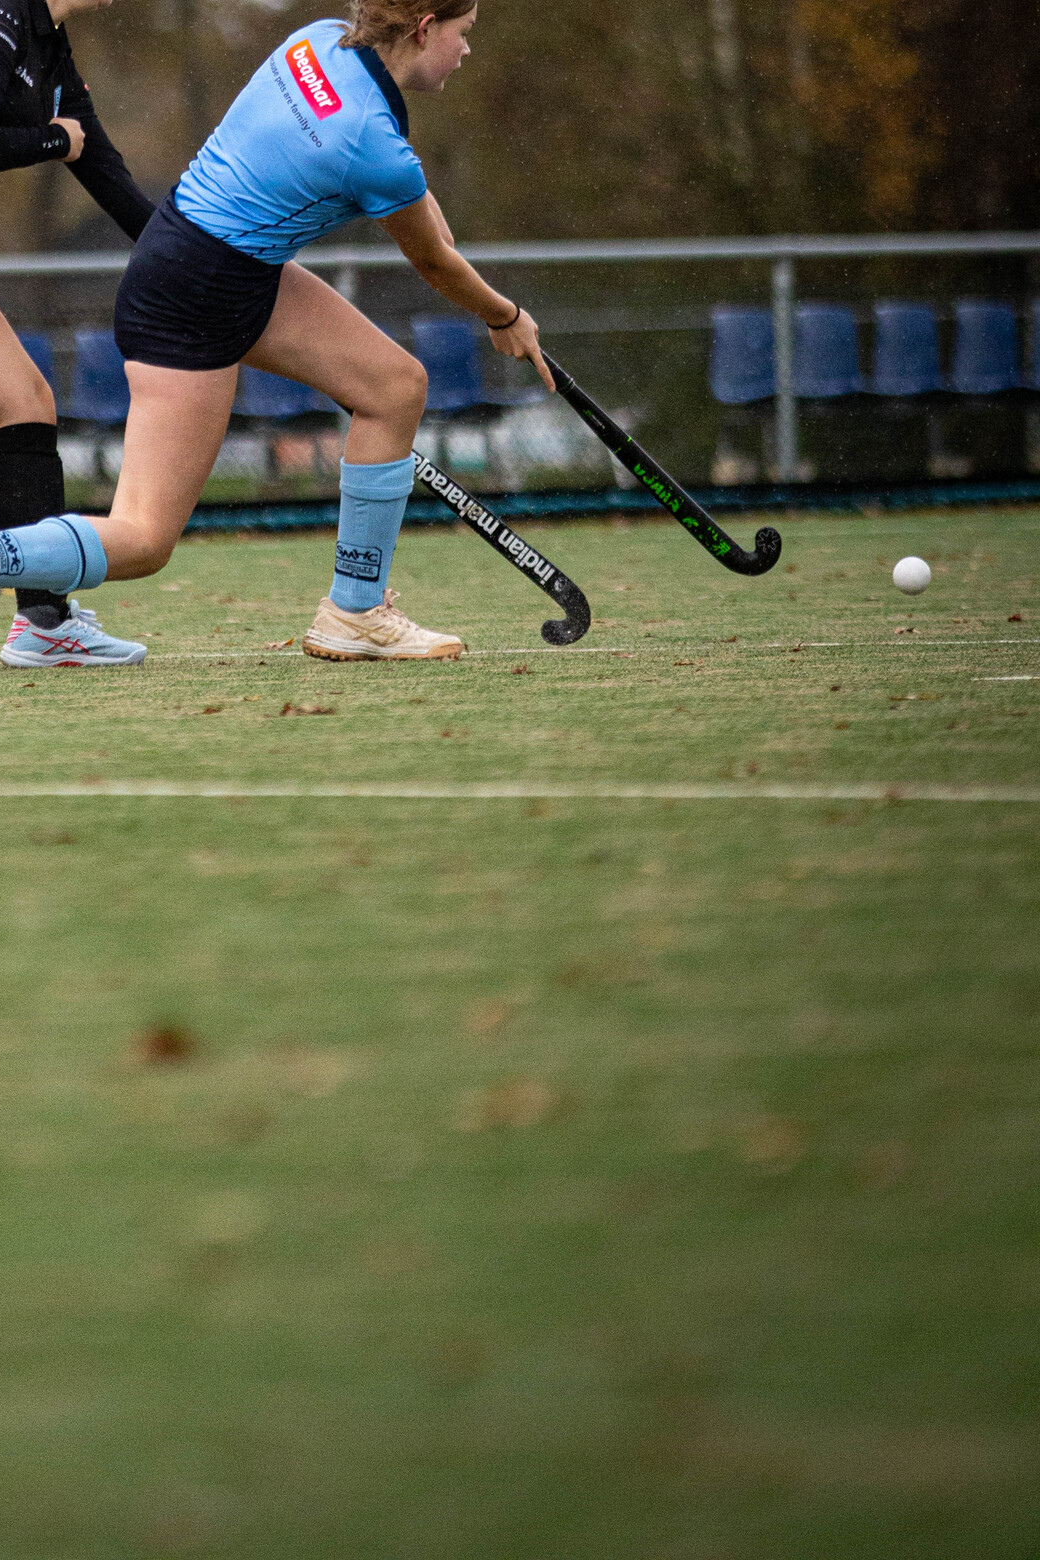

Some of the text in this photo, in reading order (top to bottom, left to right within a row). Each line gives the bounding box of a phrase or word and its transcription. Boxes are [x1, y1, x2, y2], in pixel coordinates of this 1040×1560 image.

[292, 46, 334, 108] beaphar
[275, 76, 288, 94] pets
[283, 91, 293, 105] are
[290, 103, 310, 132] family
[308, 131, 323, 148] too
[336, 545, 379, 563] SMHC
[498, 527, 556, 585] indian
